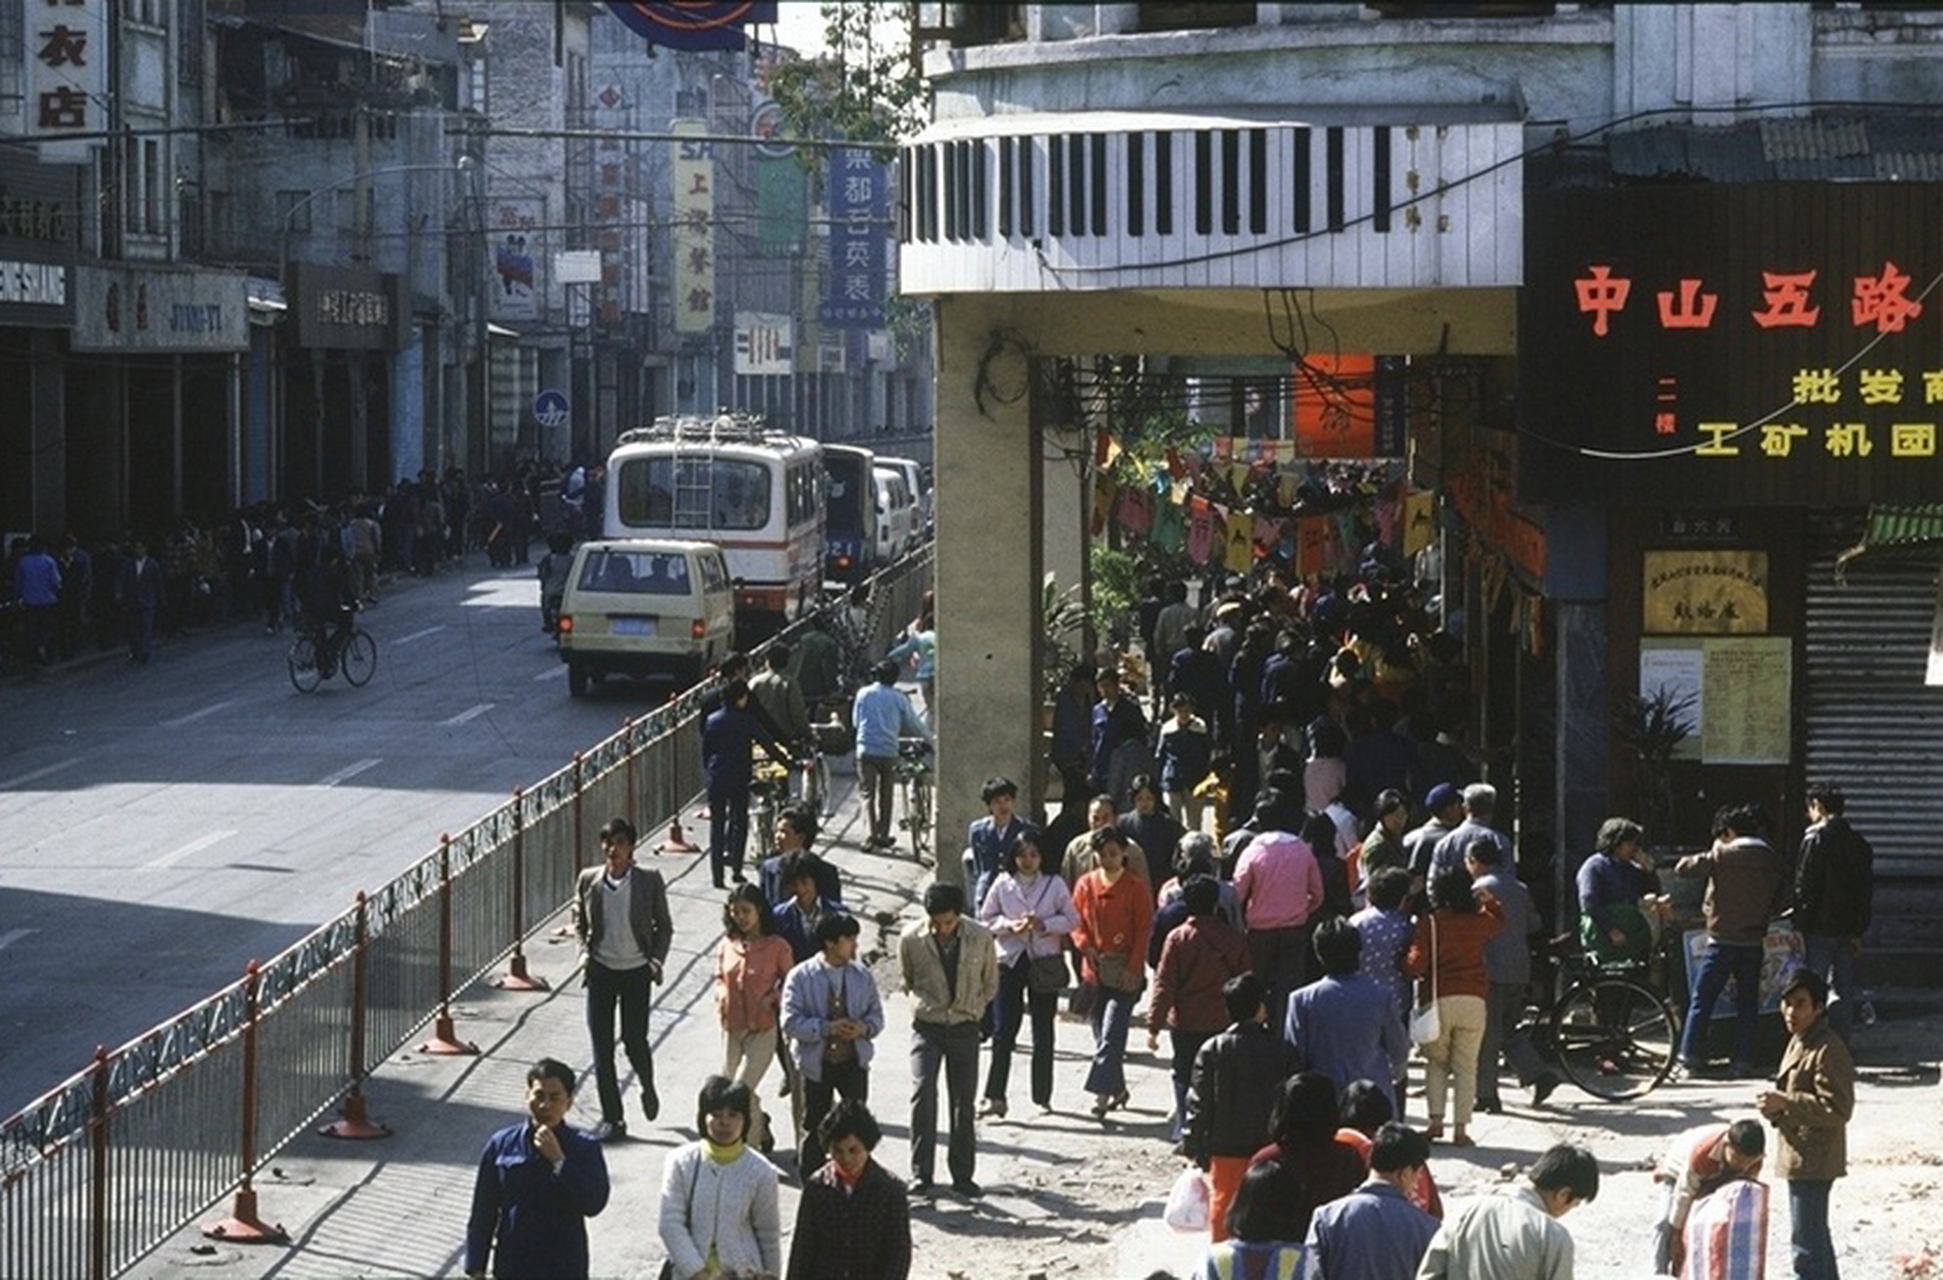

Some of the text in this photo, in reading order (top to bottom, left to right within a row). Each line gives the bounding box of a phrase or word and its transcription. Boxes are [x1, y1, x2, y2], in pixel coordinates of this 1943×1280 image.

[38, 1, 87, 127] 衣店
[1574, 261, 1923, 336] 中山五路
[1695, 423, 1936, 457] 工矿机团
